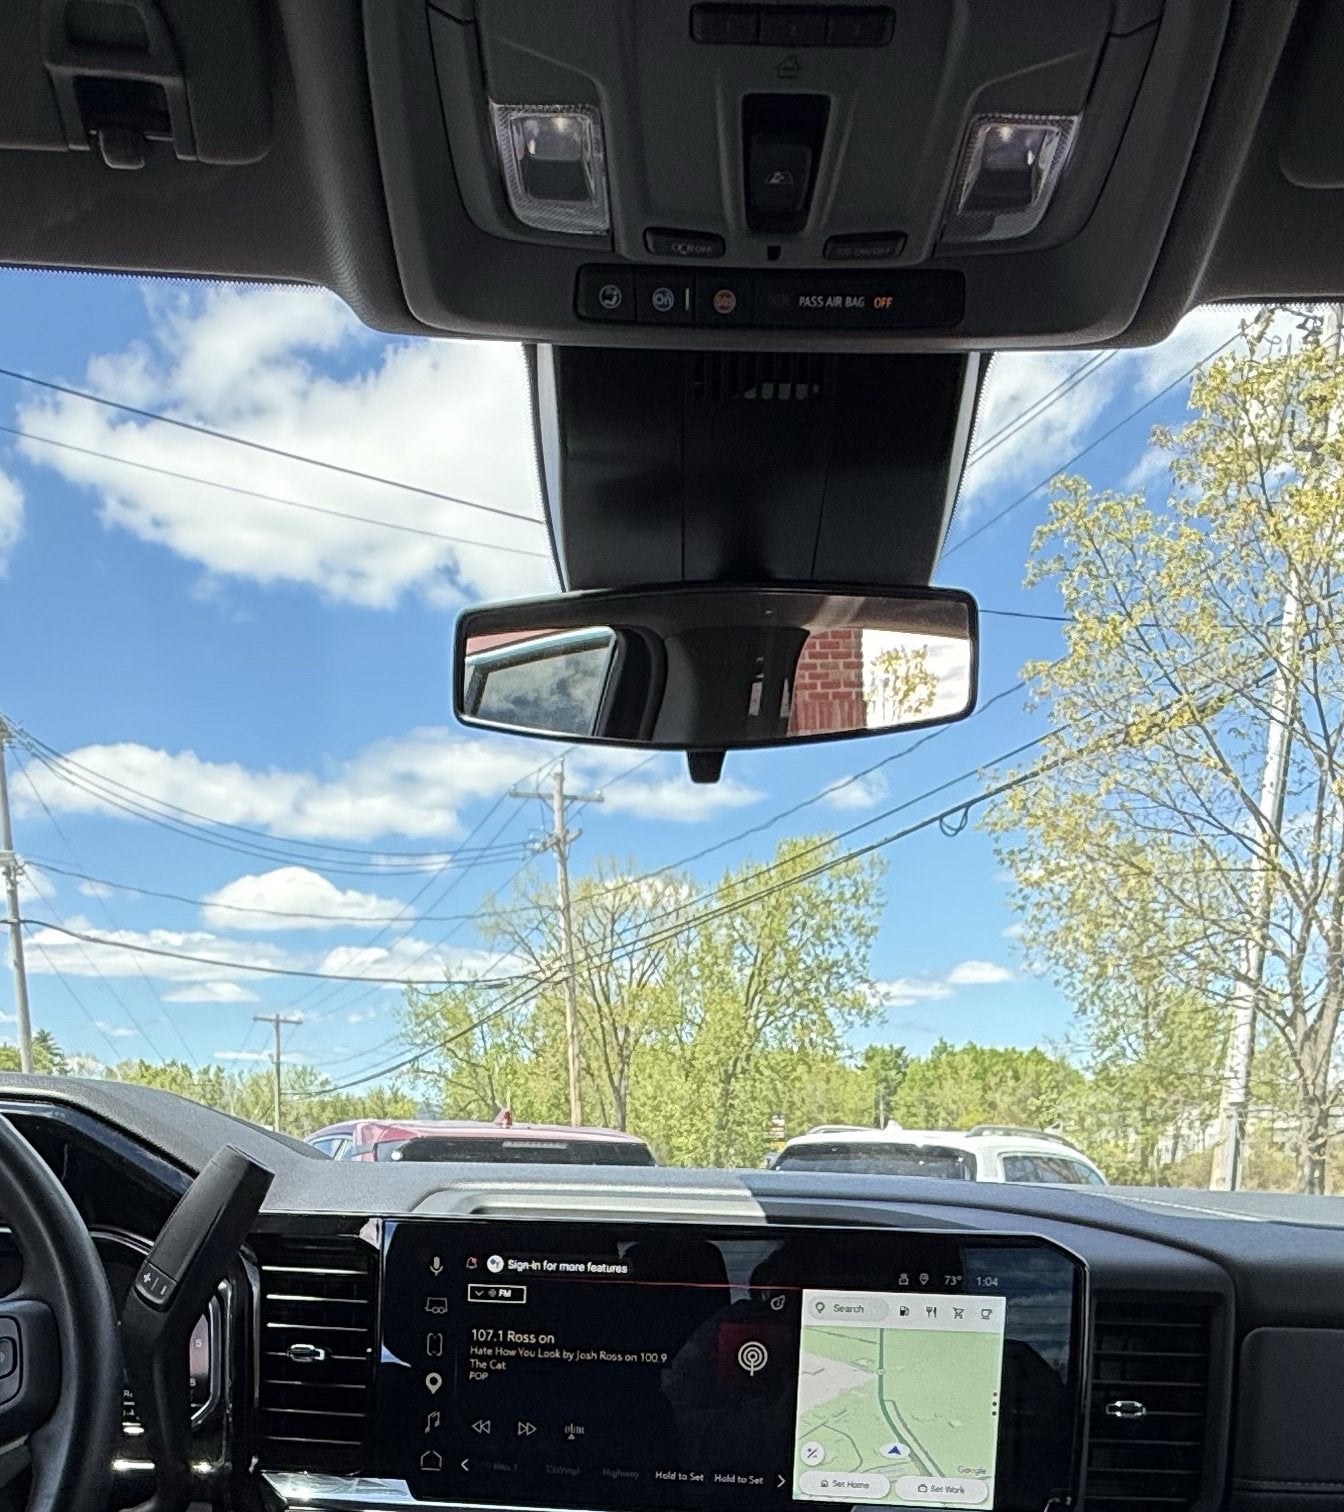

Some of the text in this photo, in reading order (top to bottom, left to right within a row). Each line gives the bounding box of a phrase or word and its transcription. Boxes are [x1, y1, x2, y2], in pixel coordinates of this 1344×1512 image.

[799, 296, 893, 309] PASS AIR BAG OFF
[507, 1258, 628, 1274] Sign-in for more features
[975, 1275, 999, 1287] 1:04
[498, 1289, 512, 1298] FM
[833, 1303, 865, 1314] Search
[471, 1328, 555, 1344] 107.1 Ross on
[469, 1345, 668, 1364] Hate How You Look by Josh Ross on 100.9
[469, 1358, 507, 1370] The Cat
[469, 1371, 489, 1381] POP
[655, 1470, 704, 1482] Hold to Set
[957, 1465, 987, 1476] Google
[714, 1473, 763, 1485] Hold to Set
[832, 1479, 870, 1489] Set Home
[930, 1484, 965, 1495] Set Work
